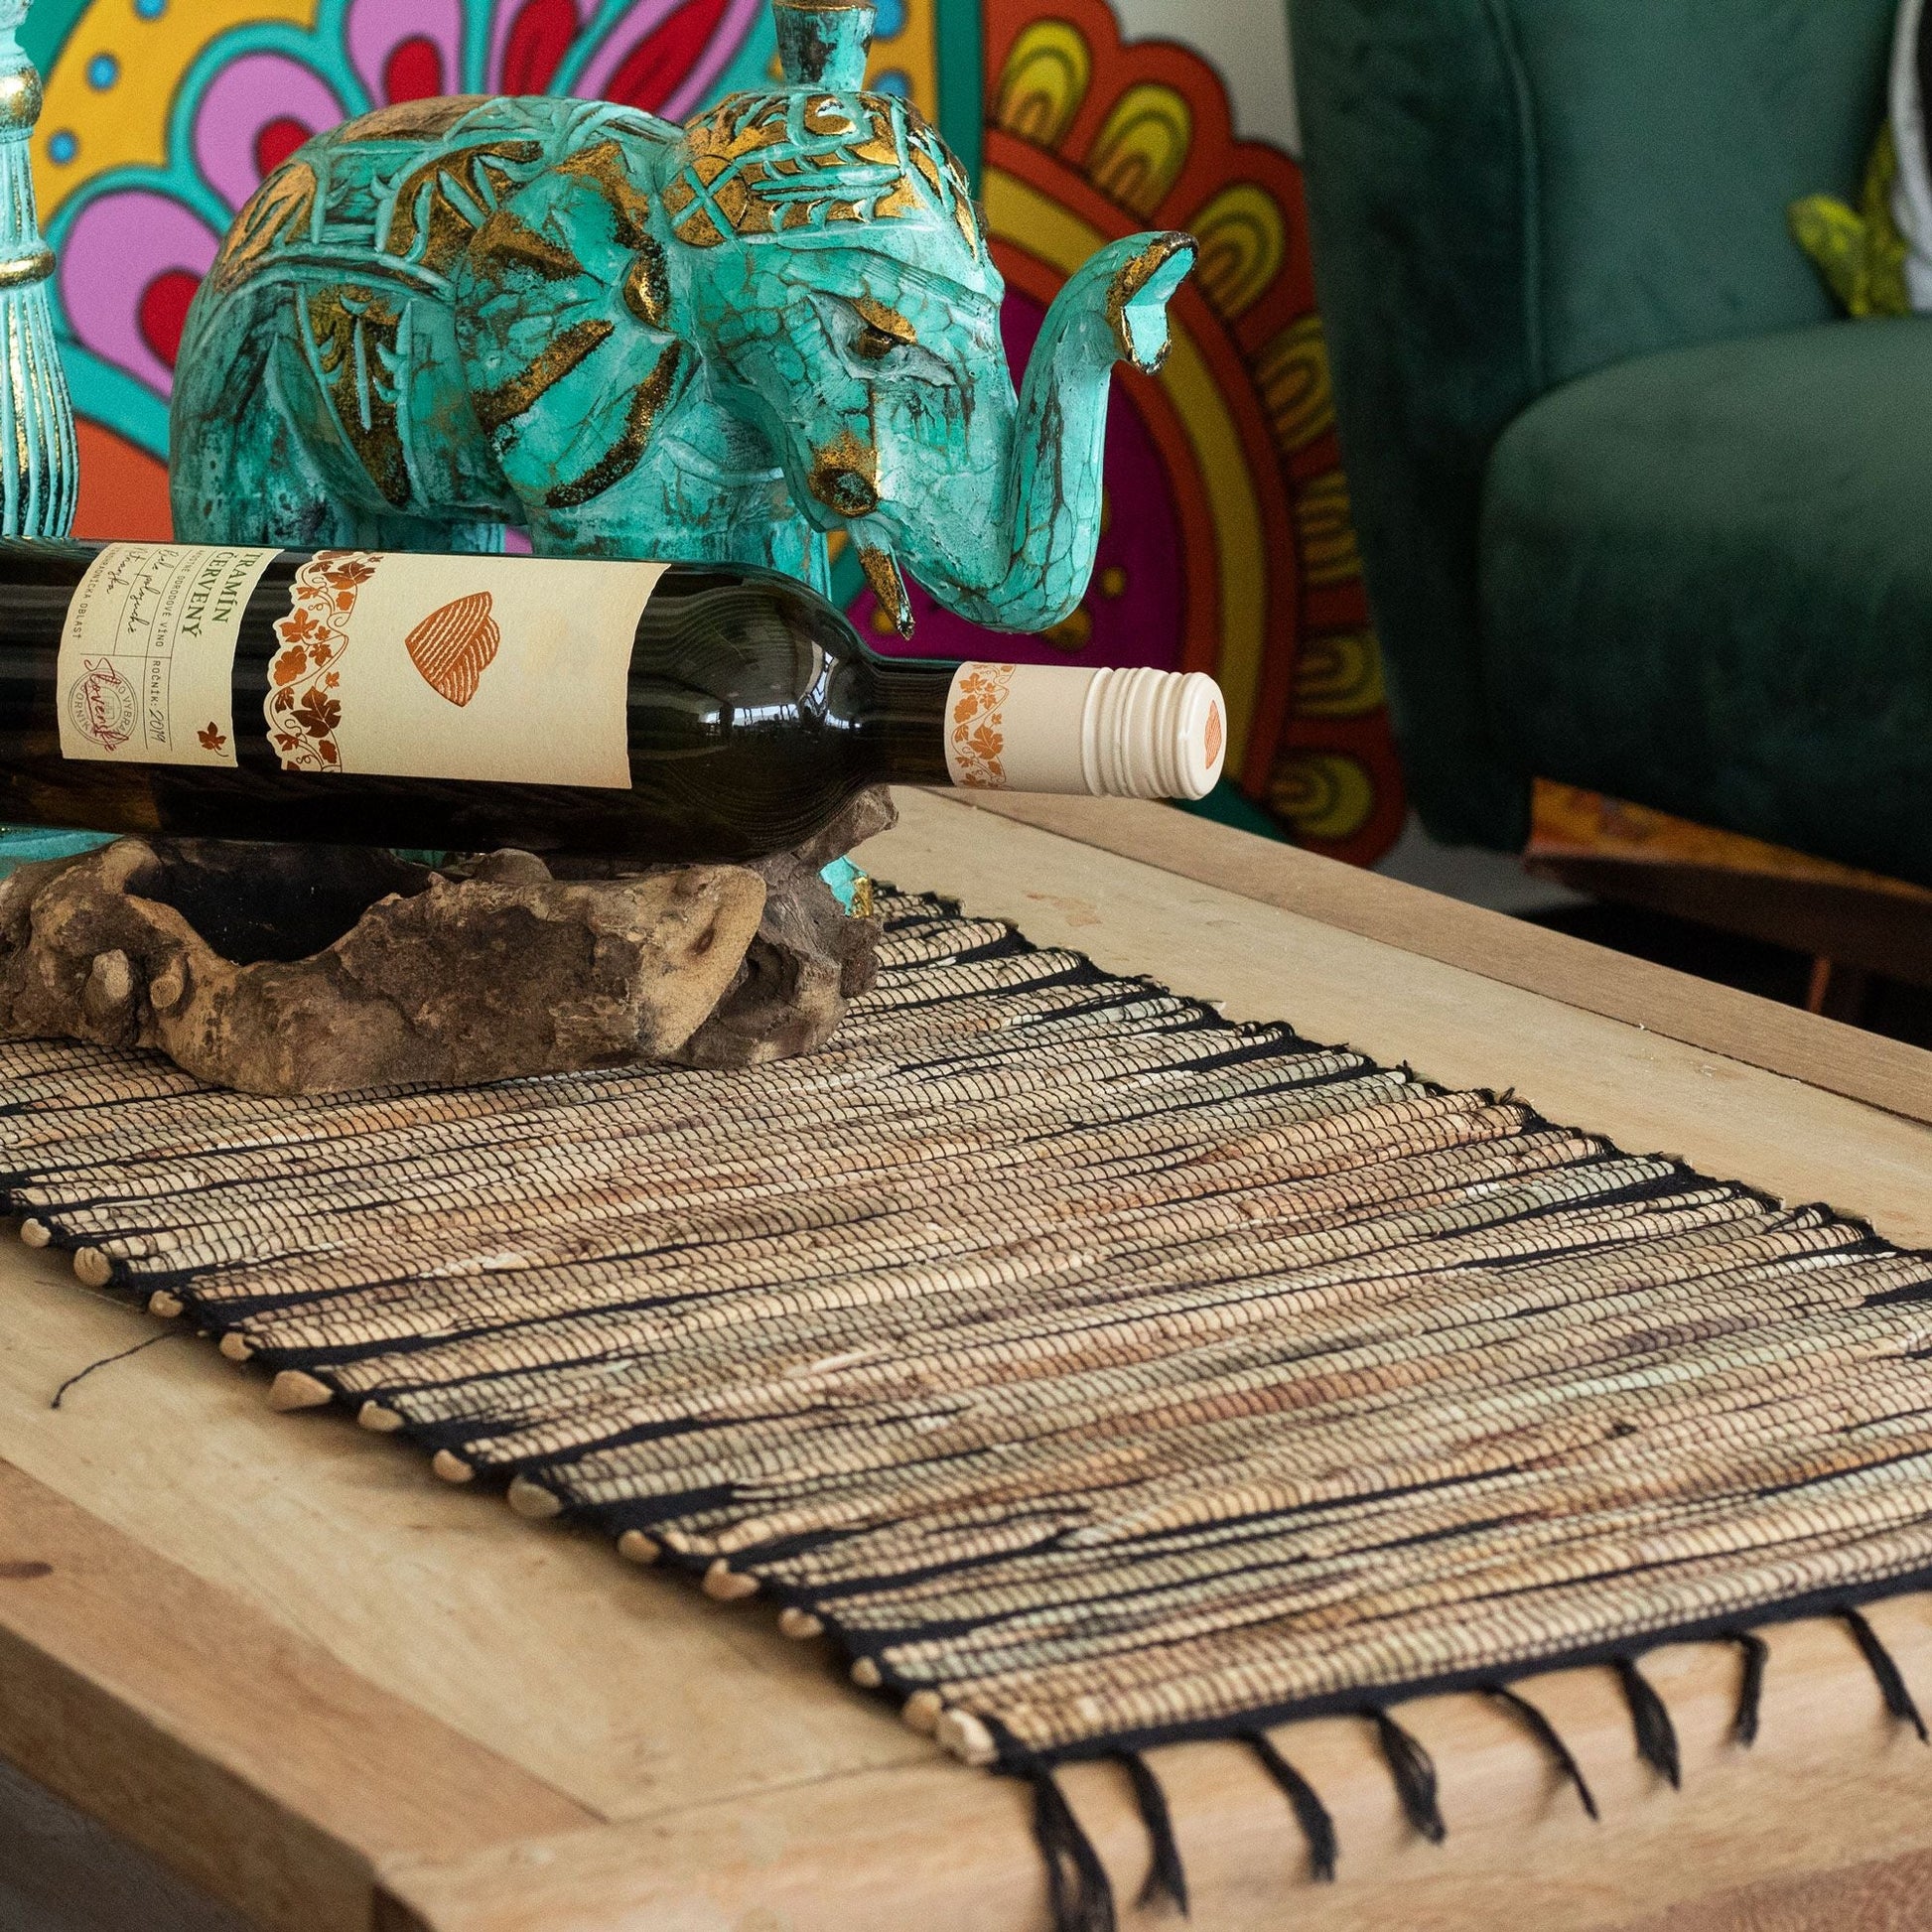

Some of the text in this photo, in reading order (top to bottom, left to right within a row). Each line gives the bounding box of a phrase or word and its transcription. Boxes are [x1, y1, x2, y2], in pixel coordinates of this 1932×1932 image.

[162, 576, 186, 617] ODRODOVÉ
[182, 552, 236, 637] ČERVENÝ
[211, 552, 263, 622] TRAMÍN
[155, 621, 169, 647] VÍNO
[149, 660, 166, 744] ROČNÍK: 2019
